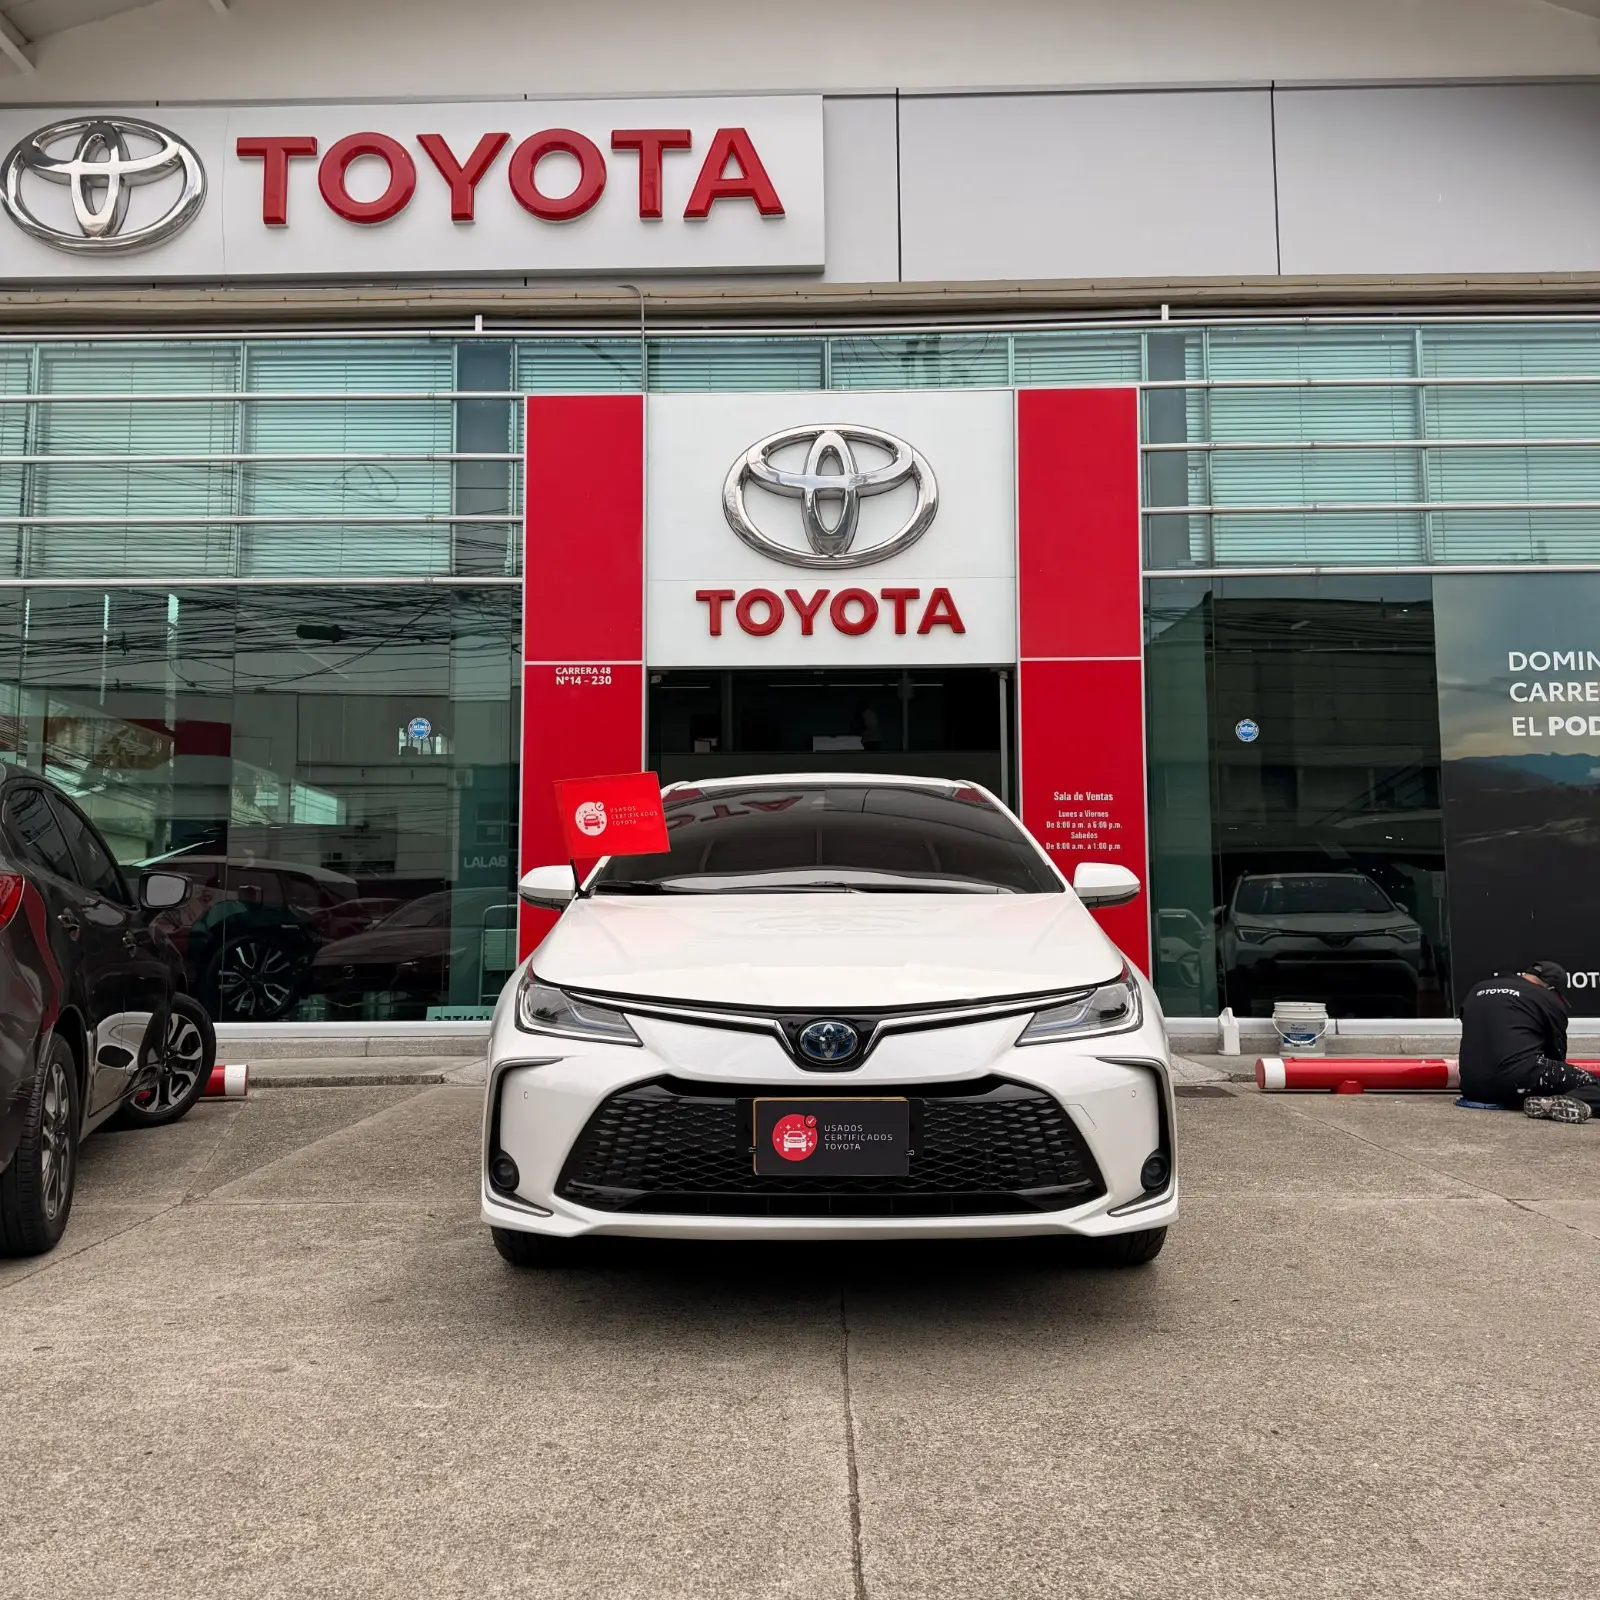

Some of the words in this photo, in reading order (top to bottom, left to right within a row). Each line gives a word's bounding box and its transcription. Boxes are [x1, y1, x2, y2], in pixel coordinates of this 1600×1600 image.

[237, 127, 785, 228] TOYOTA
[696, 587, 966, 636] TOYOTA
[1508, 651, 1600, 671] DOMIN
[555, 667, 598, 675] CARRERA
[591, 675, 612, 685] 230
[1509, 682, 1600, 702] CARRE
[1512, 716, 1543, 736] EL
[1053, 791, 1071, 801] Sala
[1073, 792, 1084, 801] de
[1086, 791, 1114, 801] Ventas
[609, 805, 637, 813] USADOS
[610, 811, 659, 820] CERTIFICADOS
[1058, 810, 1078, 818] Lunes
[1084, 810, 1109, 818] Viernes
[612, 819, 638, 827] TOYOTA
[1046, 821, 1055, 829] De
[1056, 821, 1071, 829] 8:00
[1092, 821, 1107, 829] 6:00
[1045, 842, 1055, 850] De
[1056, 842, 1070, 850] 8:00
[1093, 842, 1107, 850] 1:00
[1485, 988, 1520, 997] TOYOTA
[824, 1124, 863, 1132] USADOS
